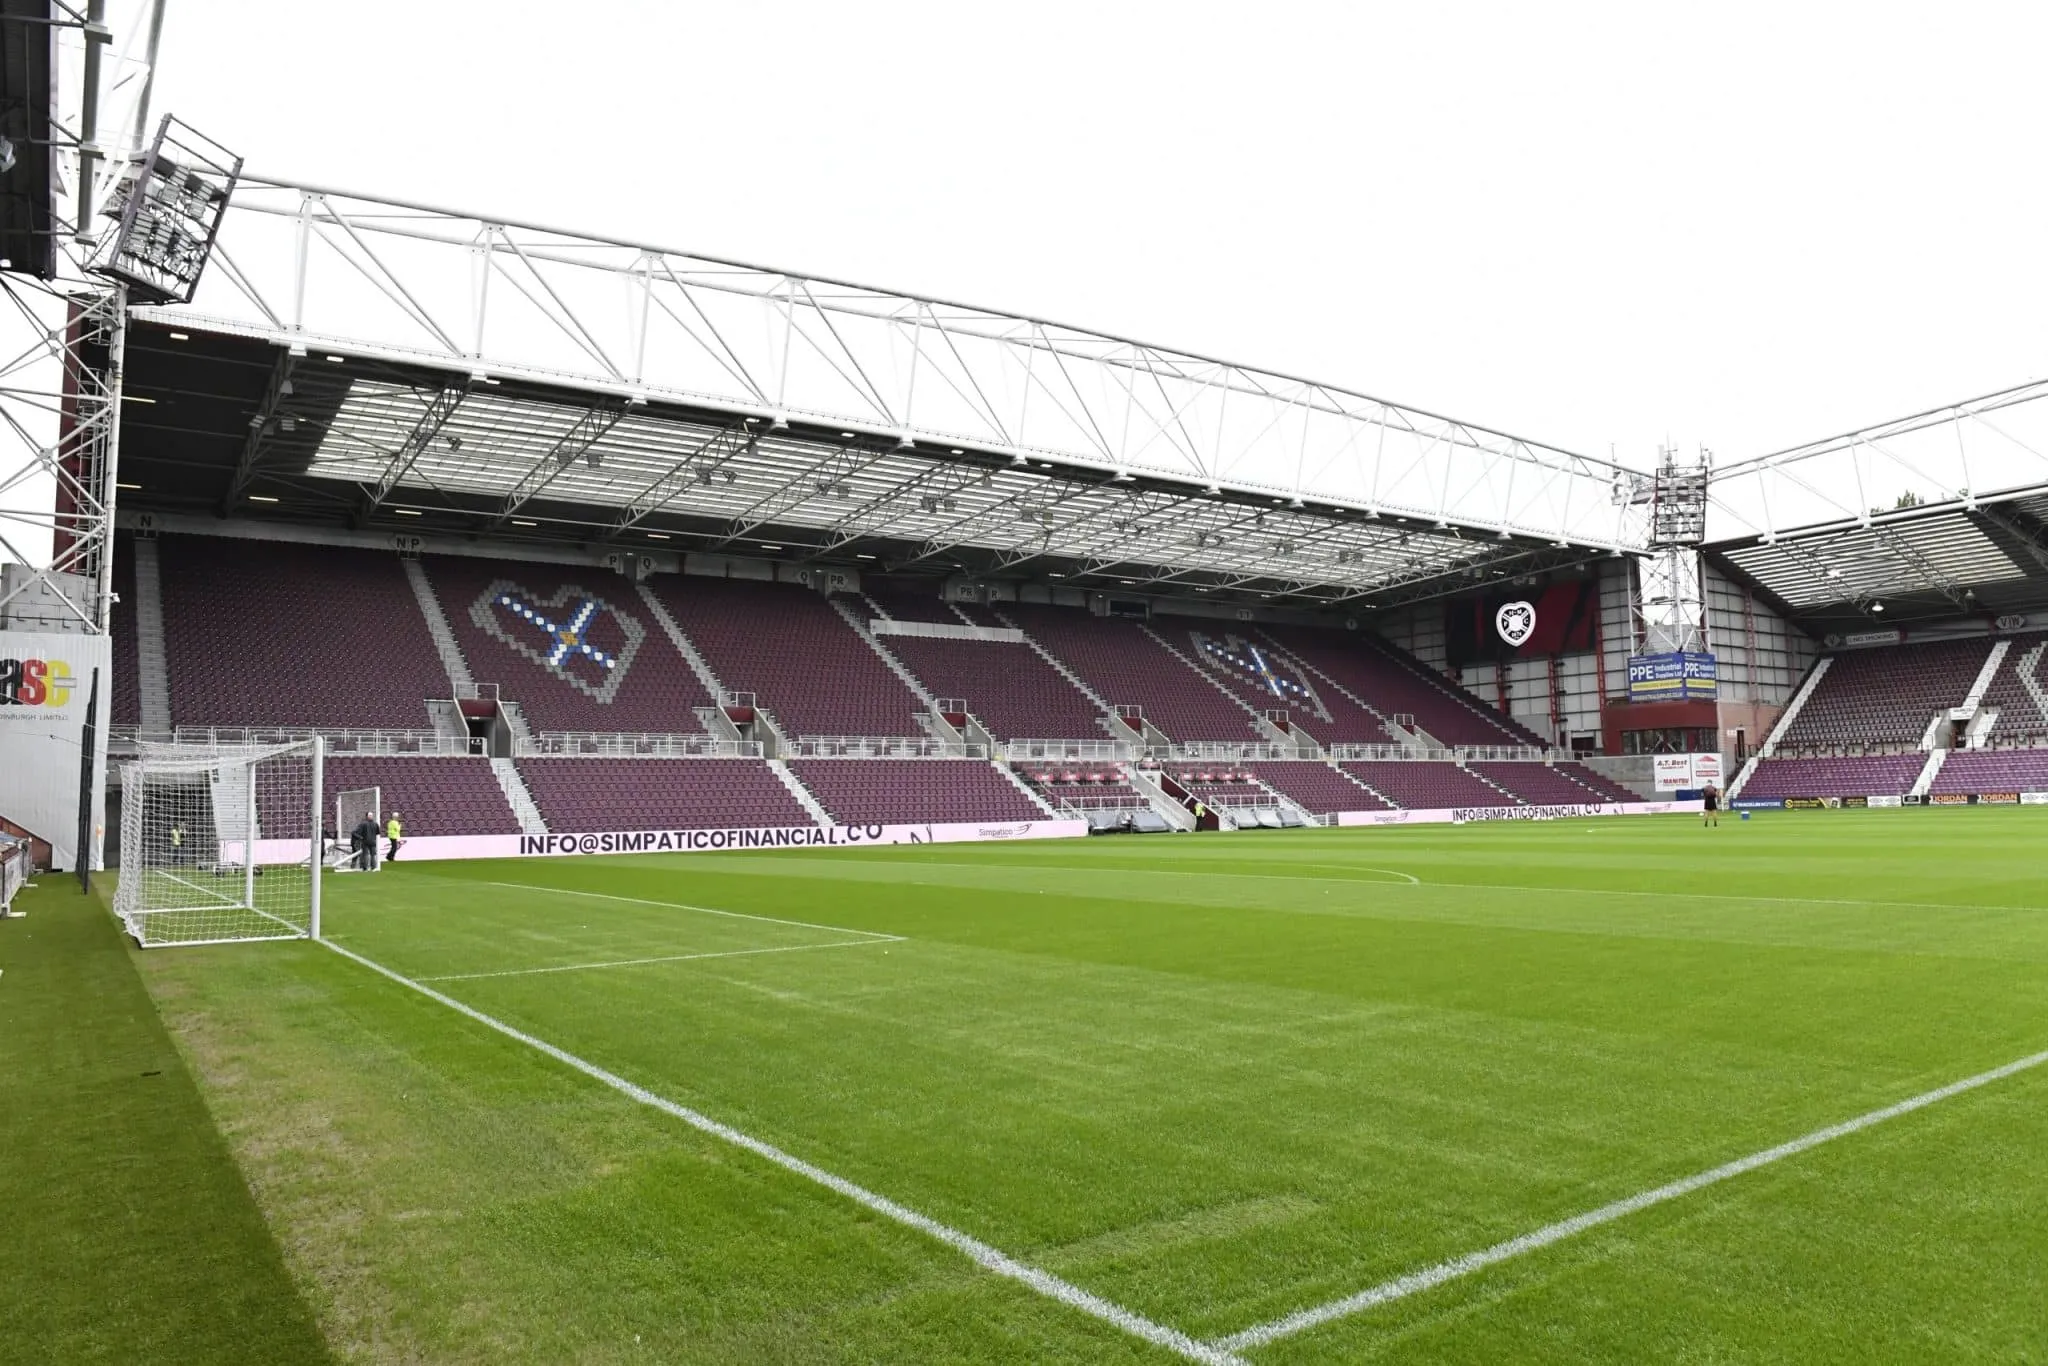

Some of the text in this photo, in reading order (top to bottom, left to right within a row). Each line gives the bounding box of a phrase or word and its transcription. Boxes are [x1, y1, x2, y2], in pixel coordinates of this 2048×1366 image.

[1630, 665, 1655, 681] PPE
[1655, 662, 1682, 673] Industrial
[1684, 662, 1700, 678] PPE
[1934, 794, 1968, 803] JORDAN
[1983, 793, 2017, 802] JORDAN
